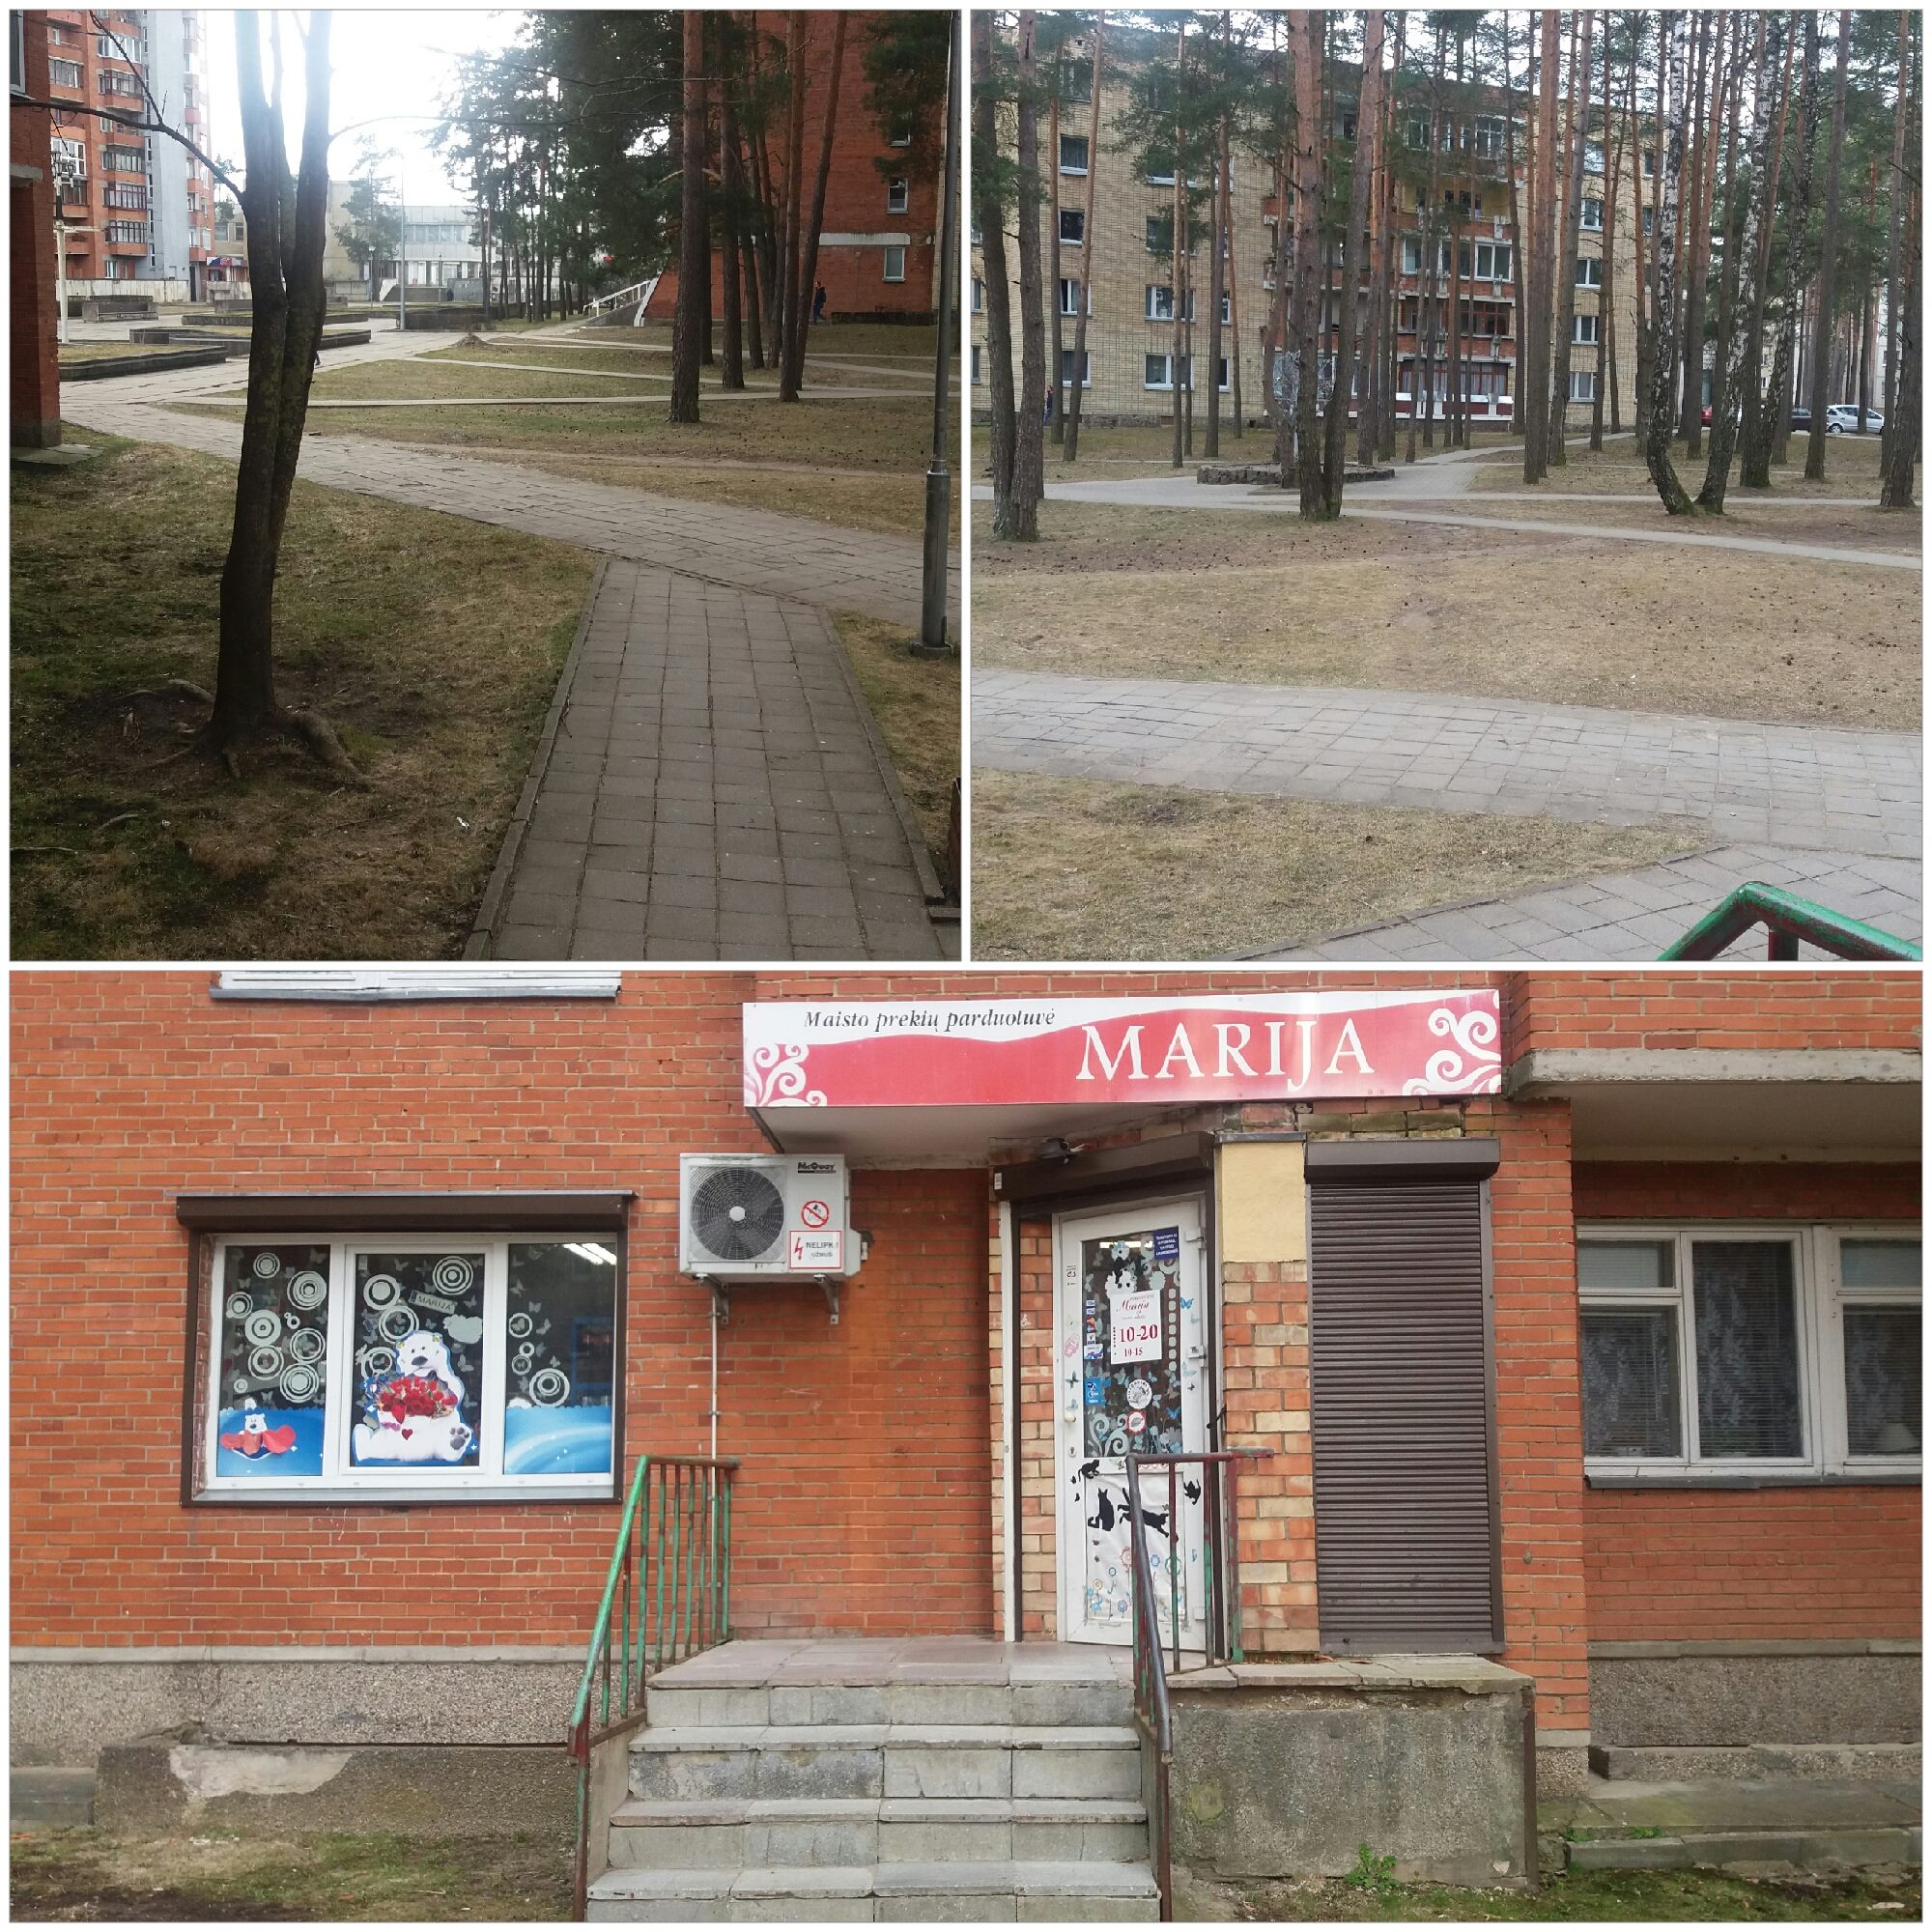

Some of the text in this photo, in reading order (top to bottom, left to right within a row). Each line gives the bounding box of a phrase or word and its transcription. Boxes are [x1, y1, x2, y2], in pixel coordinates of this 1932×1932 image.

[804, 1008, 1056, 1033] Maisto prekių parduotuvė
[1075, 1017, 1376, 1093] MARIJA
[418, 1295, 451, 1312] MARIJA
[1120, 1323, 1158, 1343] 10-20
